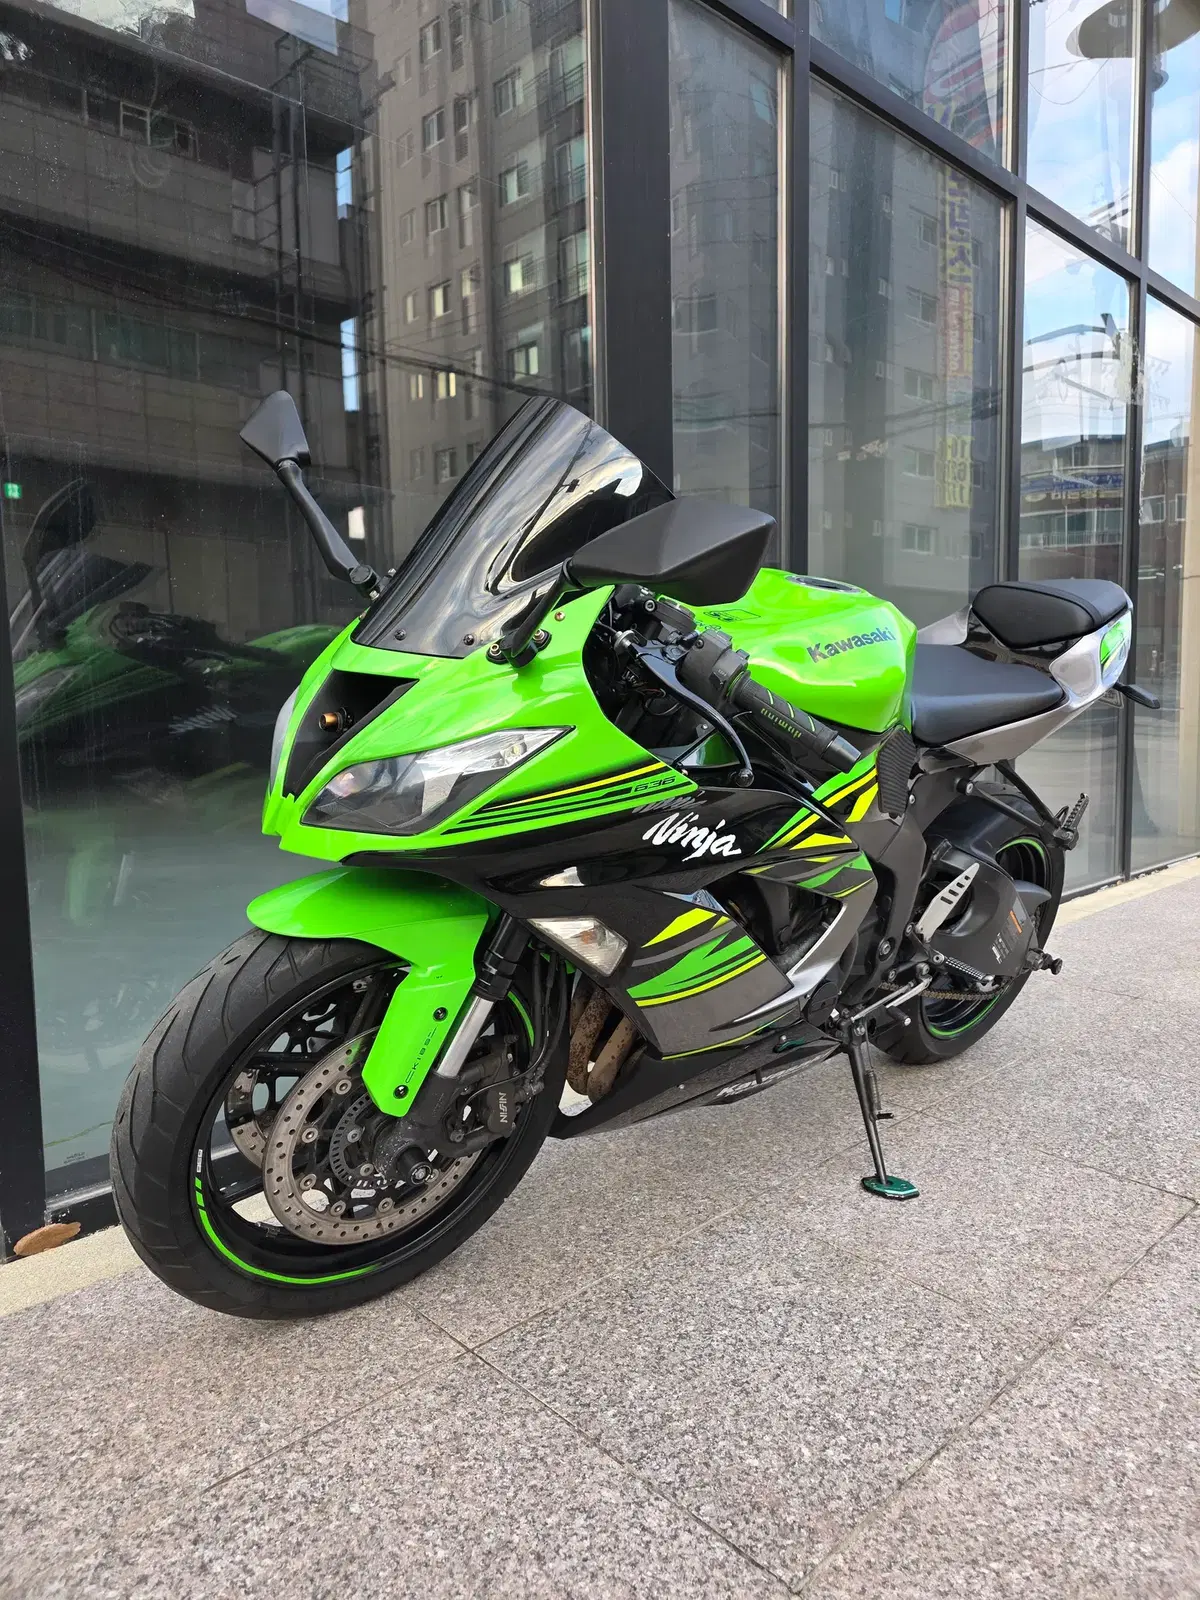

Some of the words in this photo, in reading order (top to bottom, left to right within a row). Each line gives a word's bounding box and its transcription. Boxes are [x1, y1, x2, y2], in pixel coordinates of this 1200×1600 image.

[806, 626, 897, 664] Kawasaki
[634, 776, 677, 794] 636
[642, 811, 742, 862] Ninja
[498, 1092, 508, 1124] NISSIN
